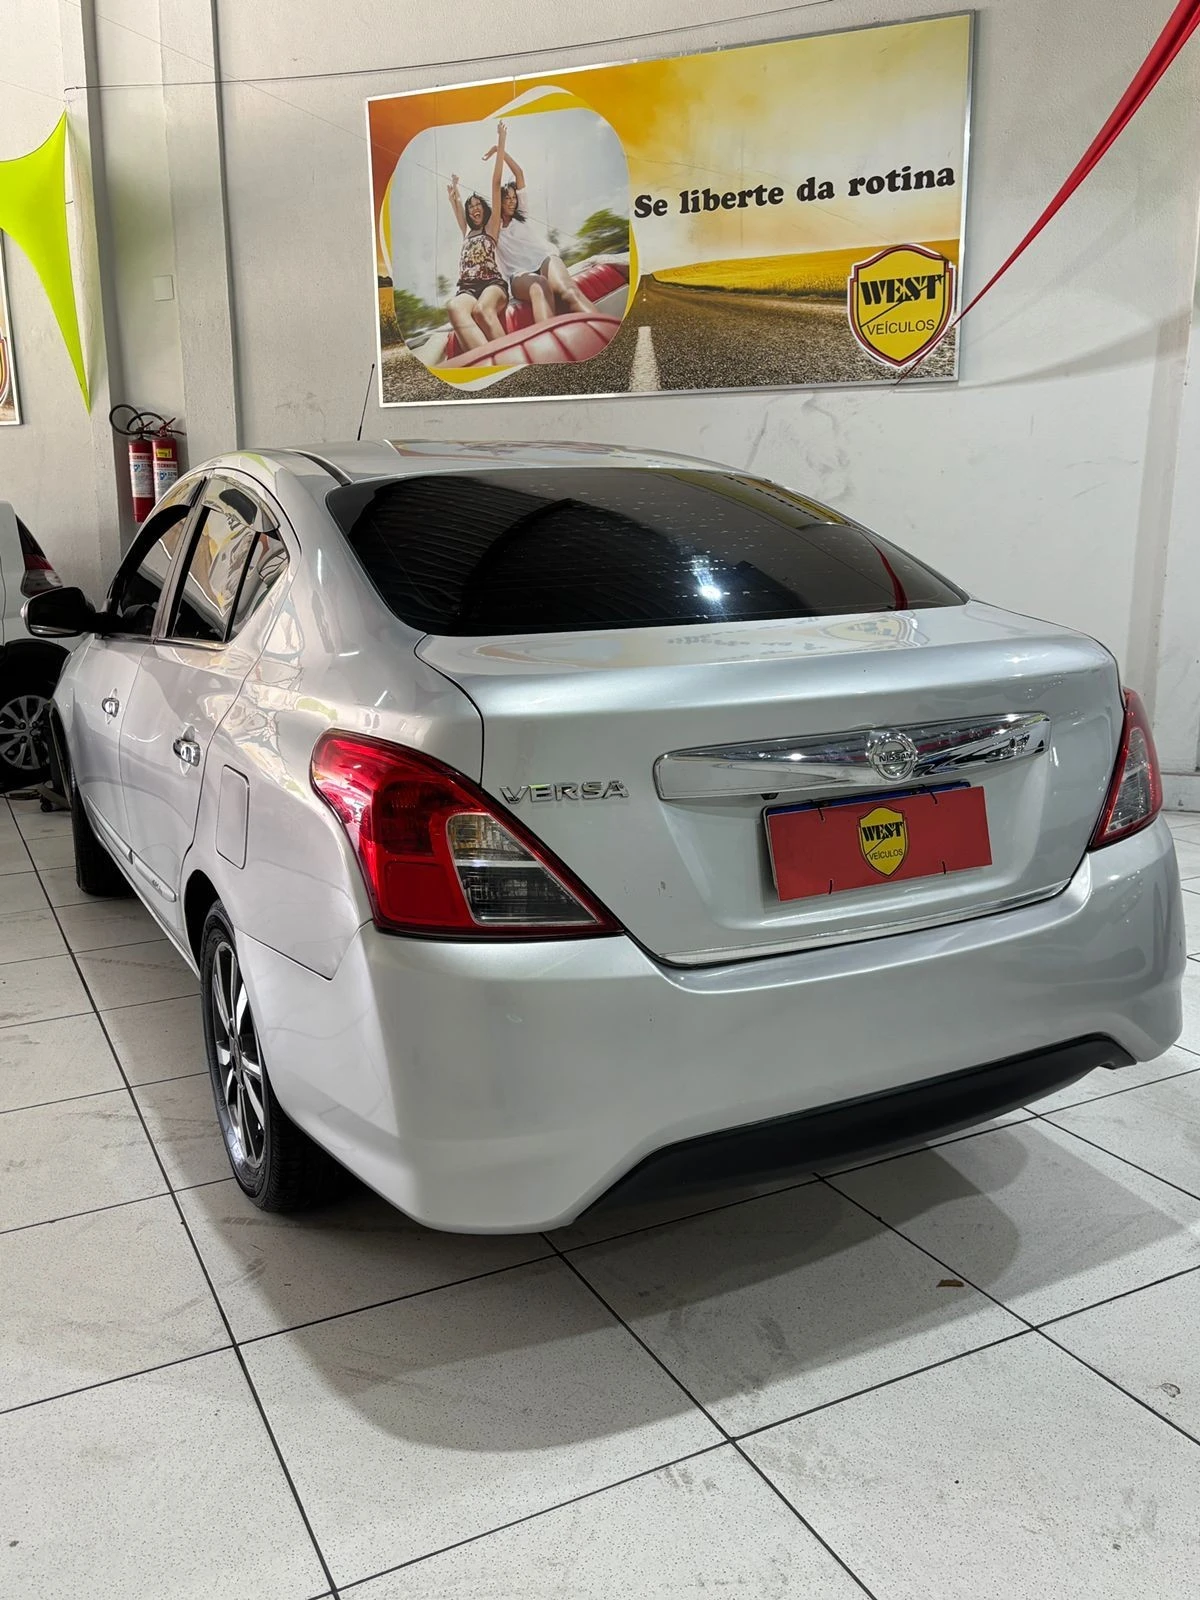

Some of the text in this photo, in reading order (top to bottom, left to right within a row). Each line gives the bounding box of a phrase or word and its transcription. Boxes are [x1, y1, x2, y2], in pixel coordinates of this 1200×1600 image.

[634, 165, 955, 218] Se liberte da rotina
[860, 273, 943, 306] WEST
[866, 319, 935, 335] VEÍCULOS
[879, 751, 912, 763] NISSAN
[500, 780, 630, 804] VERSA
[862, 821, 904, 842] WEST
[869, 848, 904, 860] VEÍCULOS
